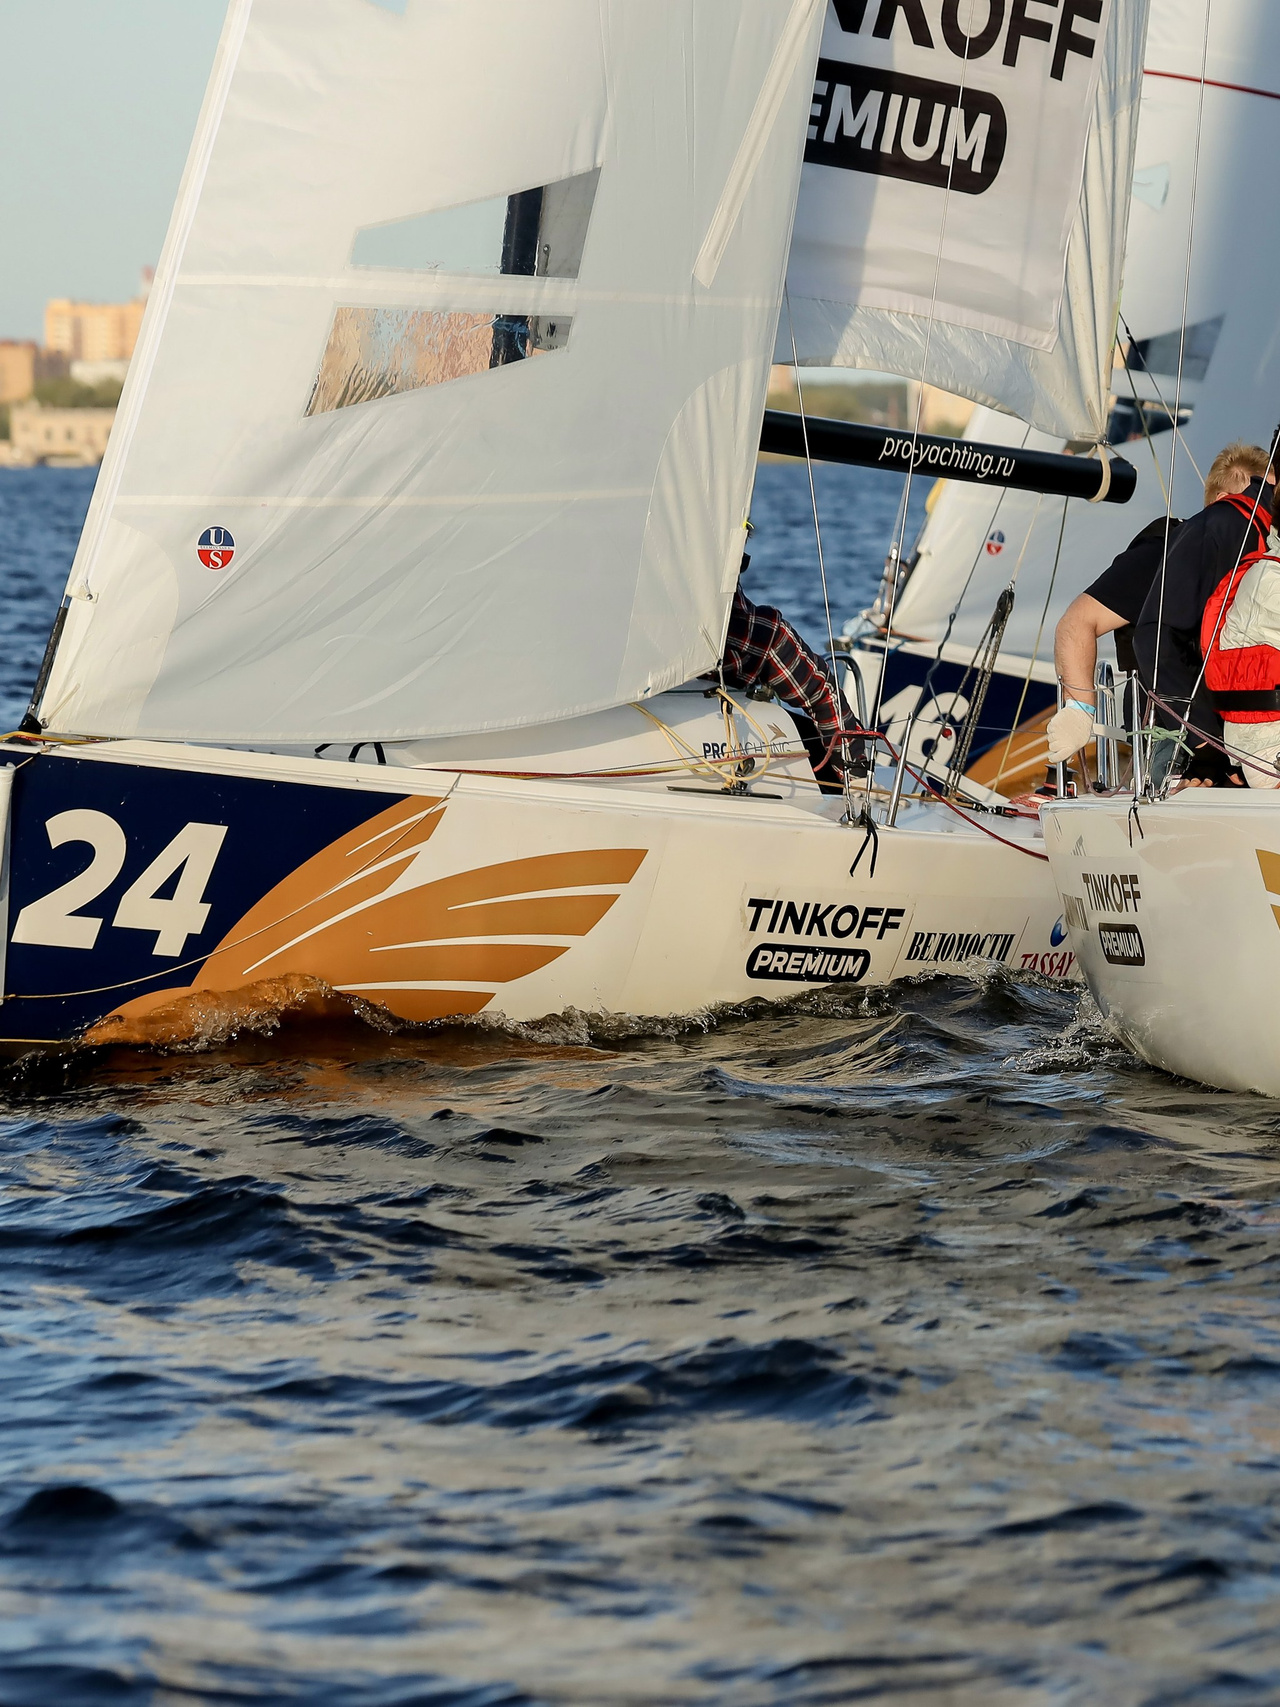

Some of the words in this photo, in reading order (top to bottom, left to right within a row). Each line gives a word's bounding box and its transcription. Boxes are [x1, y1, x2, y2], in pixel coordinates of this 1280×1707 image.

[878, 436, 1016, 479] pro-yachting.ru
[209, 528, 225, 546] U
[209, 550, 224, 569] S
[10, 808, 229, 958] 24
[1082, 873, 1141, 913] TINKOFF
[747, 898, 906, 940] TINKOFF
[905, 932, 1016, 965] ВЕДОМОСТИ
[1101, 931, 1142, 957] PREMIUM
[752, 949, 865, 978] PREMIUM
[1020, 951, 1075, 977] TASSAY
